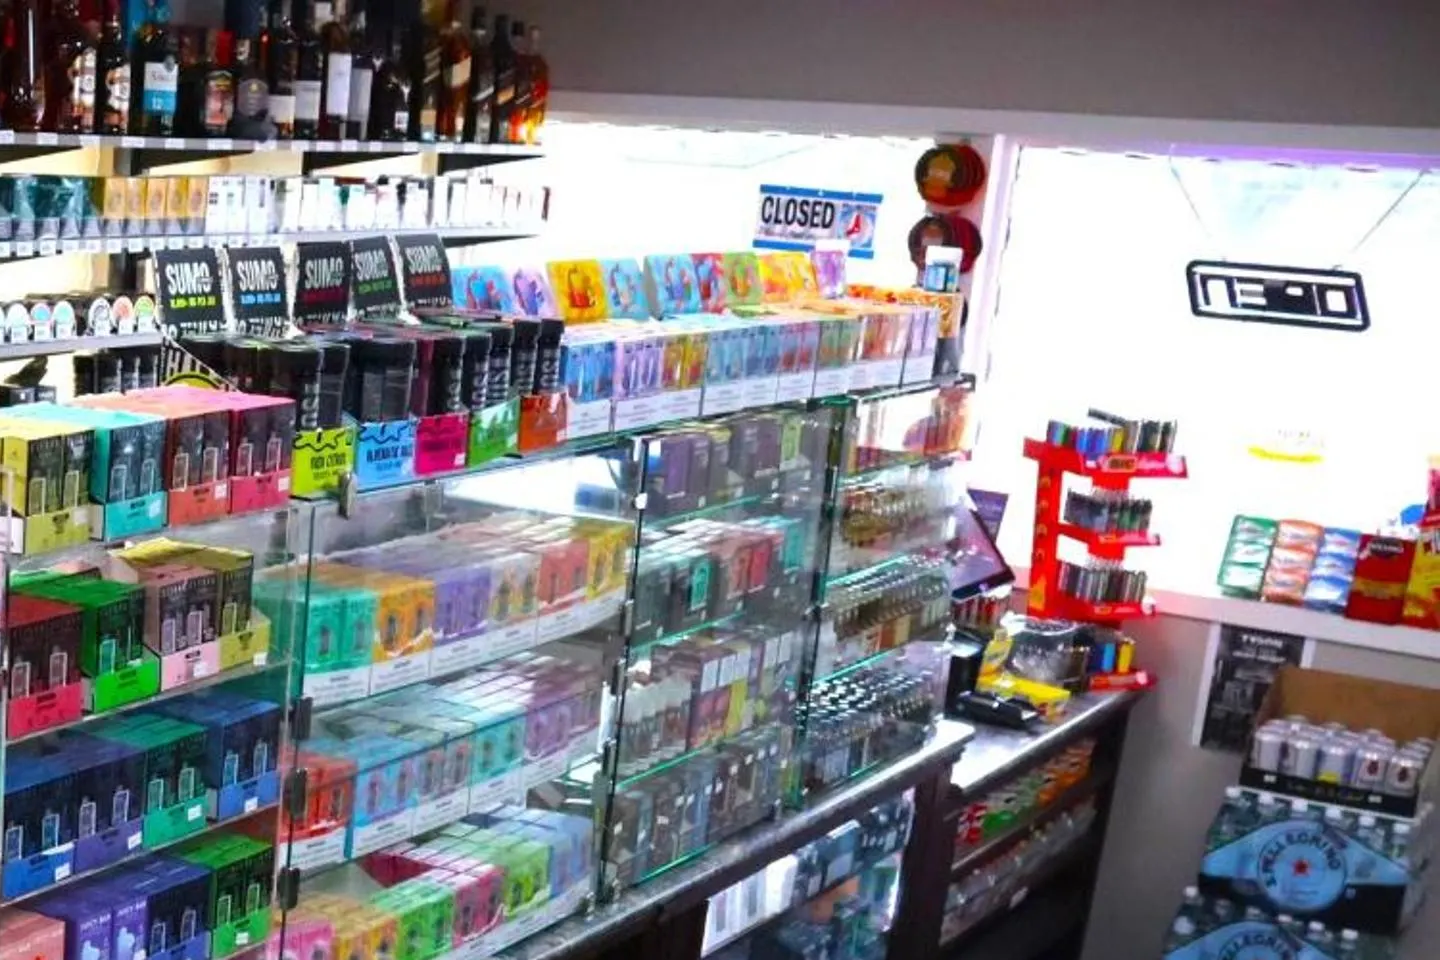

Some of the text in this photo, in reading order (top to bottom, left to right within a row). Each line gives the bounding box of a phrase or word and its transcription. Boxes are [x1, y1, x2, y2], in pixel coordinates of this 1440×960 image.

[761, 195, 836, 229] CLOSED
[165, 261, 213, 295] SUMO
[237, 259, 278, 292] SUMO
